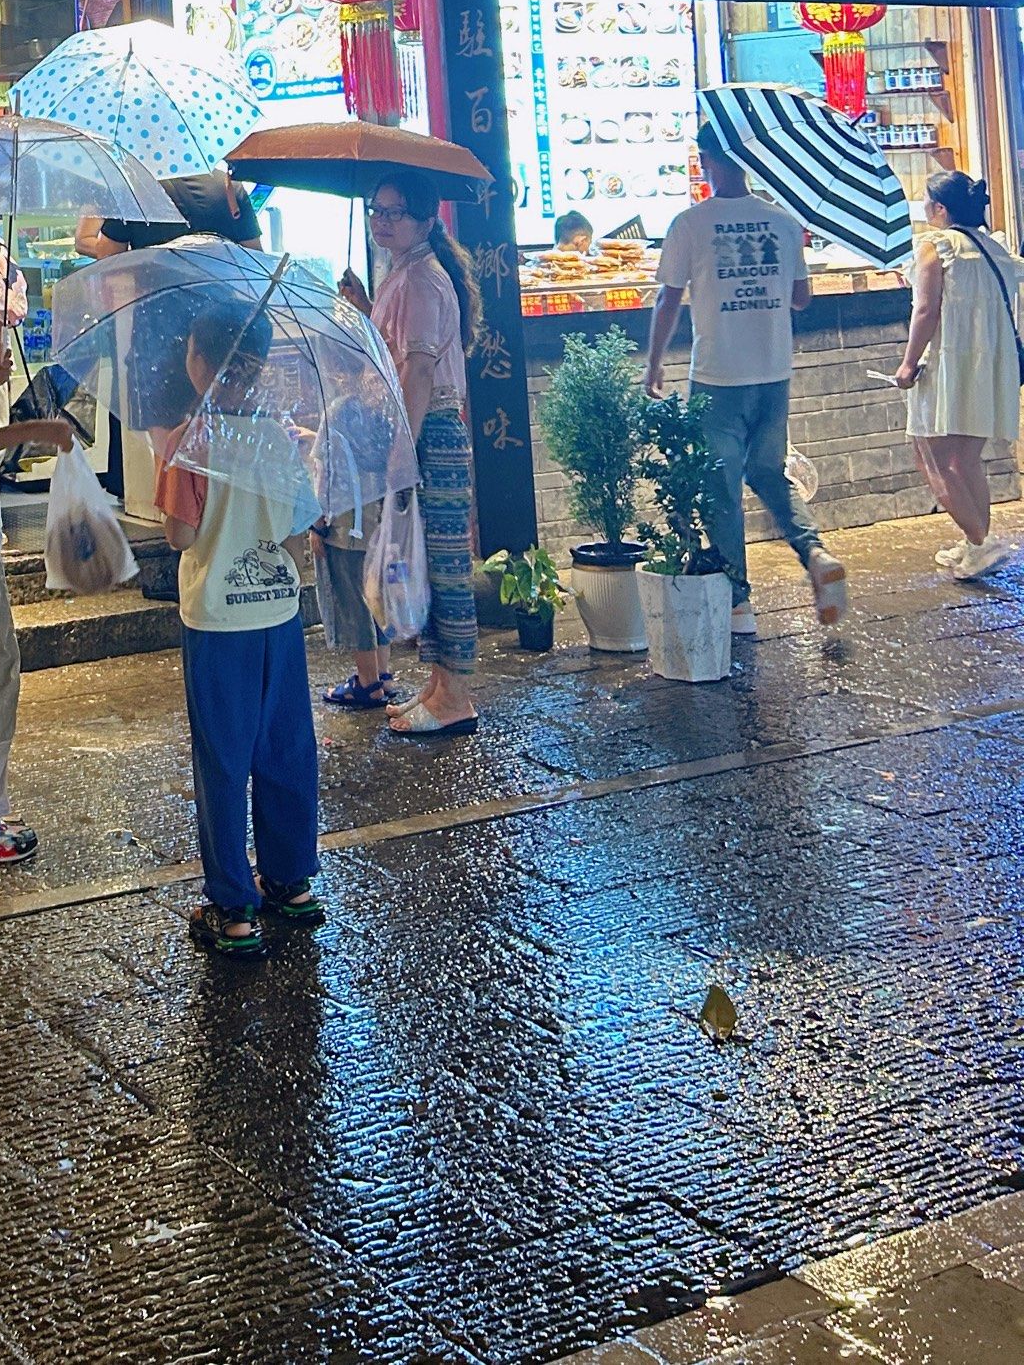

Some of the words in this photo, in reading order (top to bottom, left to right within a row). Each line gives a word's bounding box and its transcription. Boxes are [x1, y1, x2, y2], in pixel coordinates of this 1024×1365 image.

[714, 221, 770, 234] RABBIT
[225, 590, 272, 606] SUNSET
[273, 587, 299, 600] BEA
